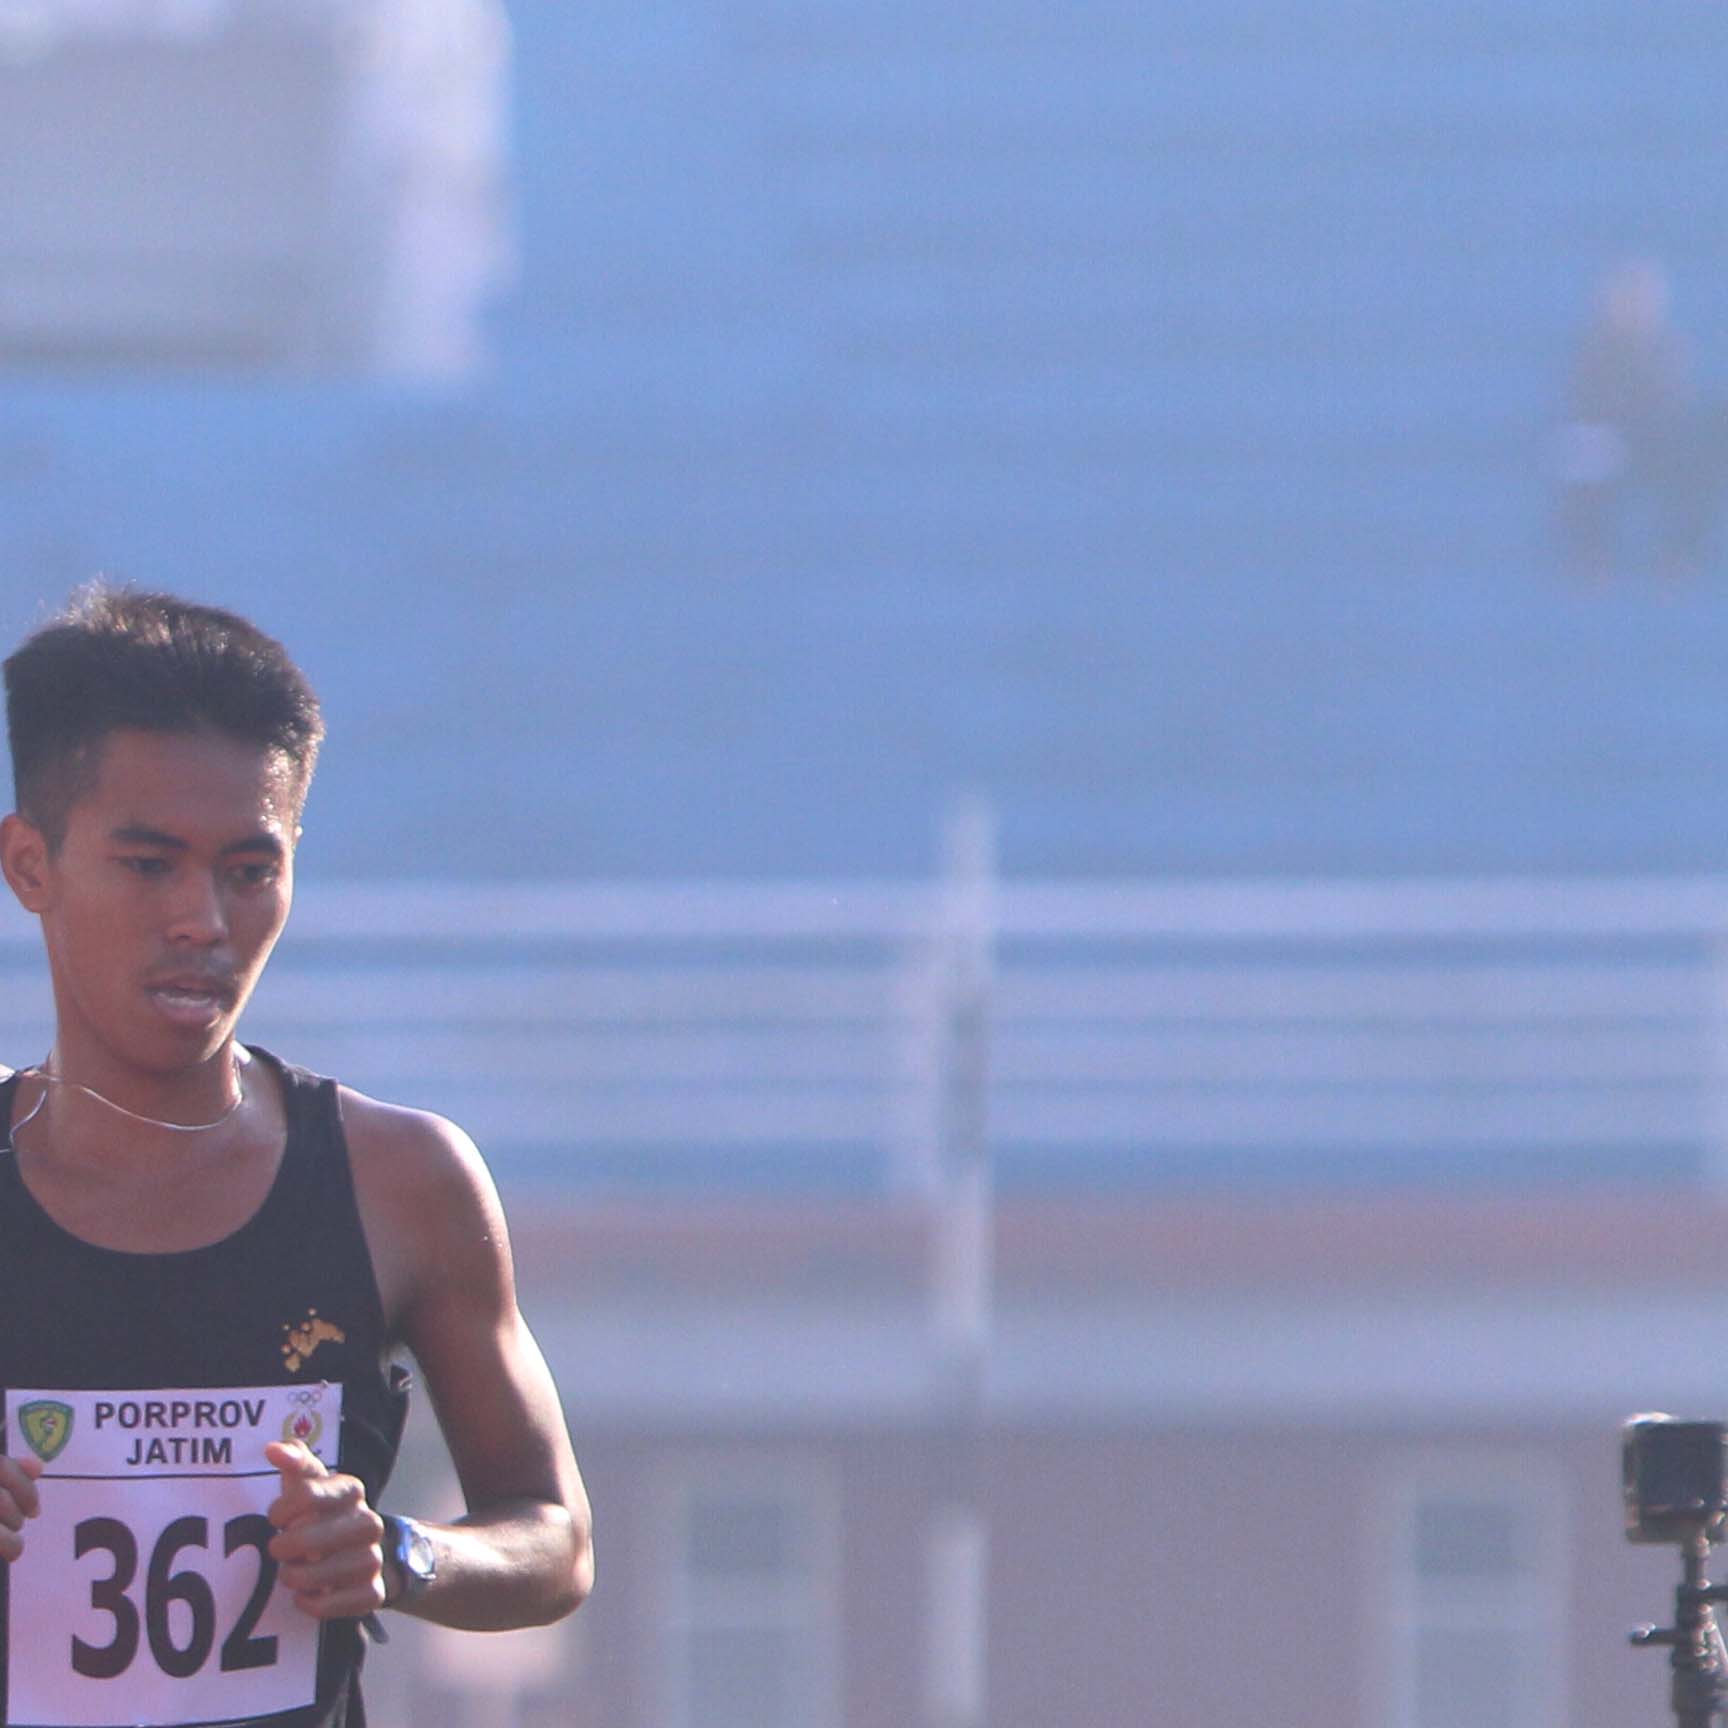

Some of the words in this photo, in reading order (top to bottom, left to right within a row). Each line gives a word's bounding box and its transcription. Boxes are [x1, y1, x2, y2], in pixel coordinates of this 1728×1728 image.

[94, 1399, 266, 1430] PORPROV
[125, 1436, 233, 1466] JATIM
[70, 1513, 280, 1679] 362
